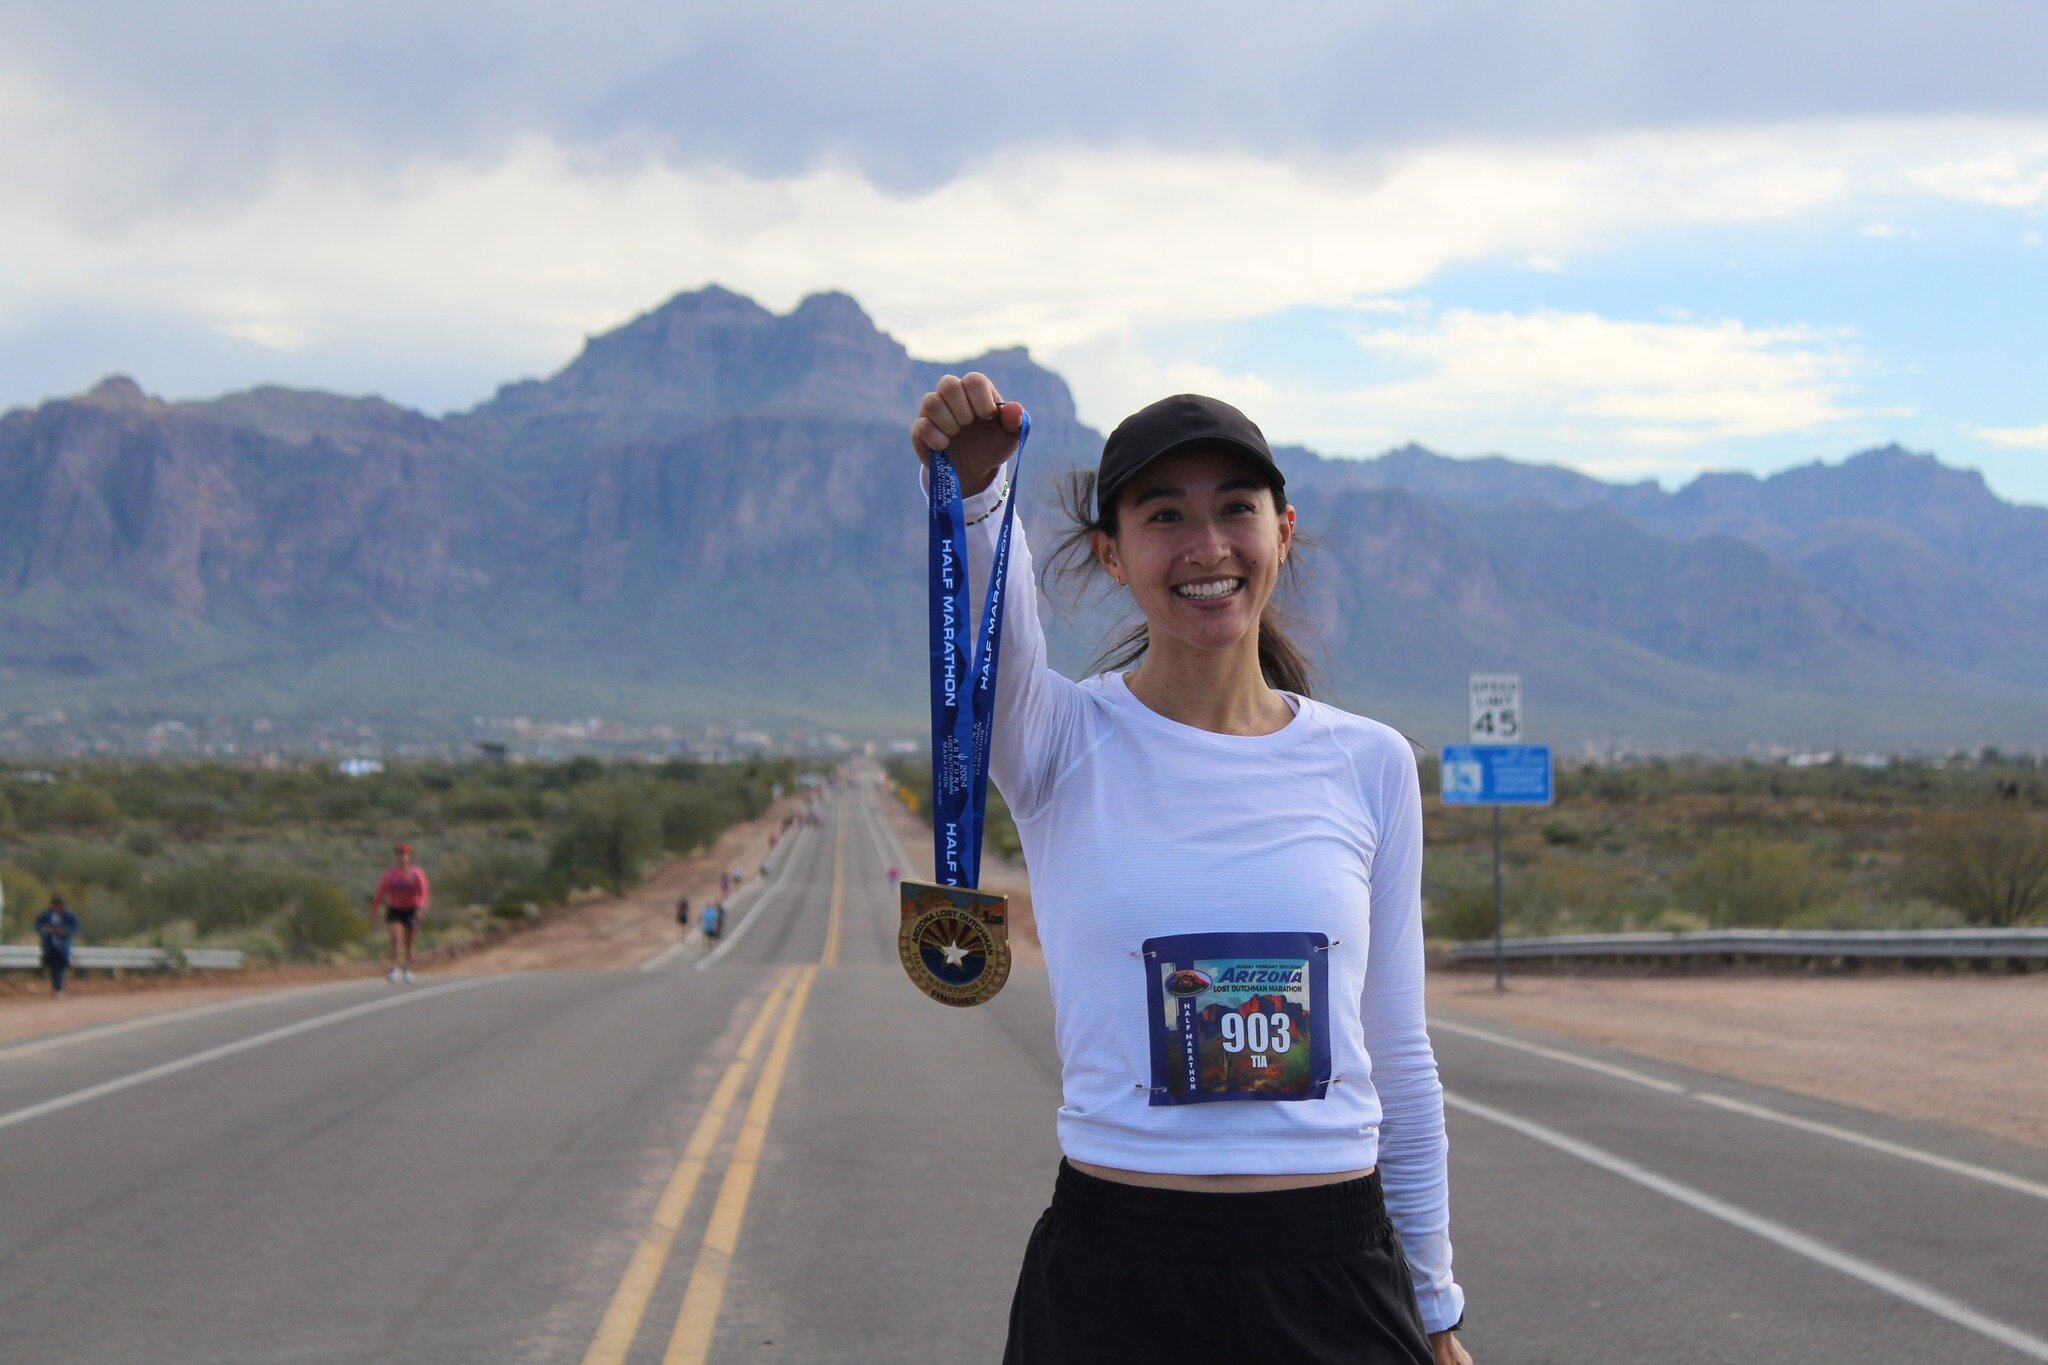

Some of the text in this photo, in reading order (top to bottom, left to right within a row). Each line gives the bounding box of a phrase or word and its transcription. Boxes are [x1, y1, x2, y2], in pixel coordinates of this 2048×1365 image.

[942, 540, 956, 707] HALF MARATHON
[980, 524, 1008, 690] HALF MARATHON
[1472, 711, 1518, 736] 45
[960, 764, 968, 788] 2024
[946, 822, 957, 873] HALF
[911, 909, 994, 956] ARIZONA LOST DUTCHMAN
[1213, 985, 1303, 993] LOST DUTCHMAN MARATHON
[1218, 966, 1303, 983] ARIZONA
[930, 989, 978, 1004] FINISHER
[1183, 1003, 1197, 1090] HALF MARATHON
[1221, 1012, 1292, 1053] 903
[1250, 1055, 1268, 1068] TIA
